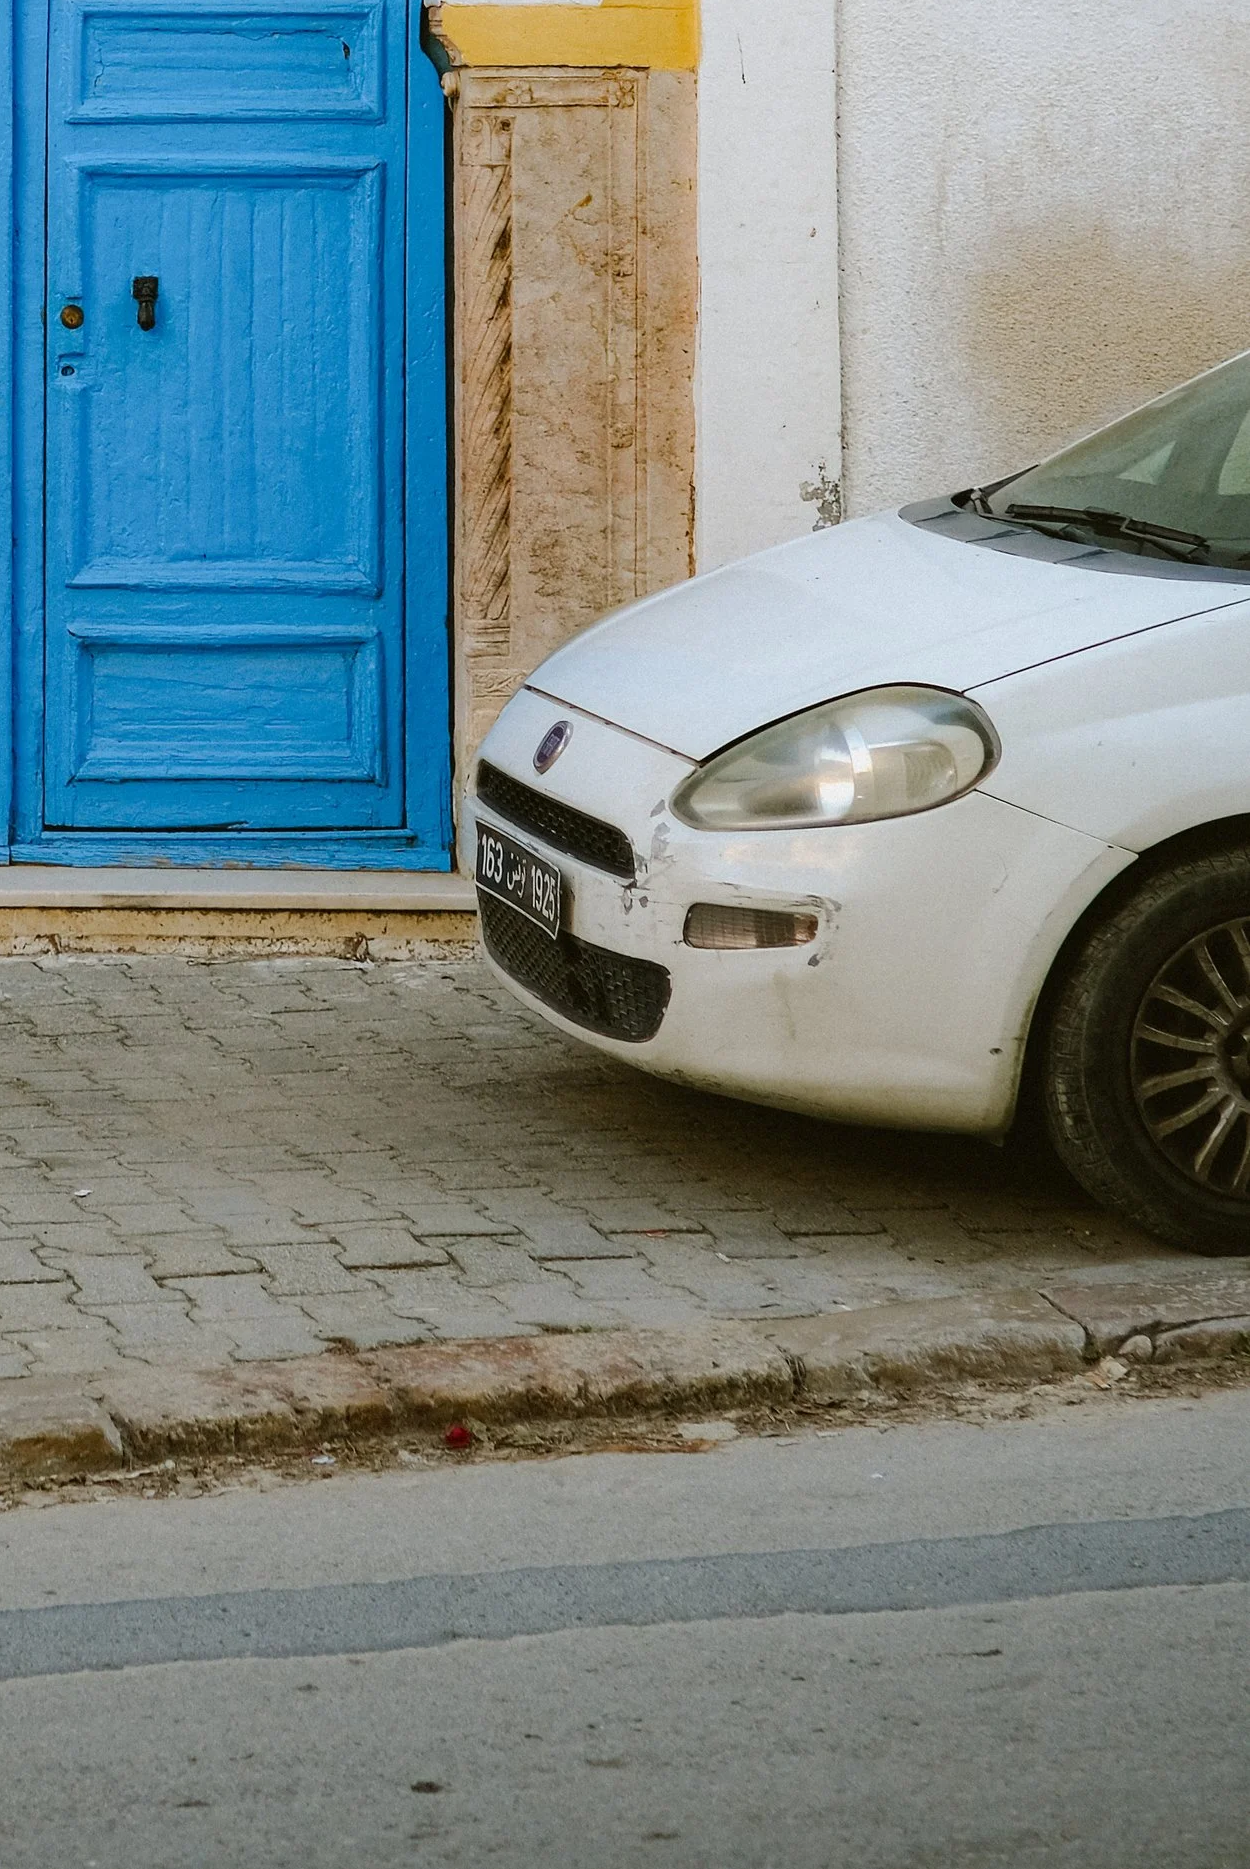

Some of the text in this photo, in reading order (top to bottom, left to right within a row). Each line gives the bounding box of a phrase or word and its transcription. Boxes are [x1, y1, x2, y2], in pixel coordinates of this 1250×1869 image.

[481, 833, 556, 922] 163 تونس 1925
